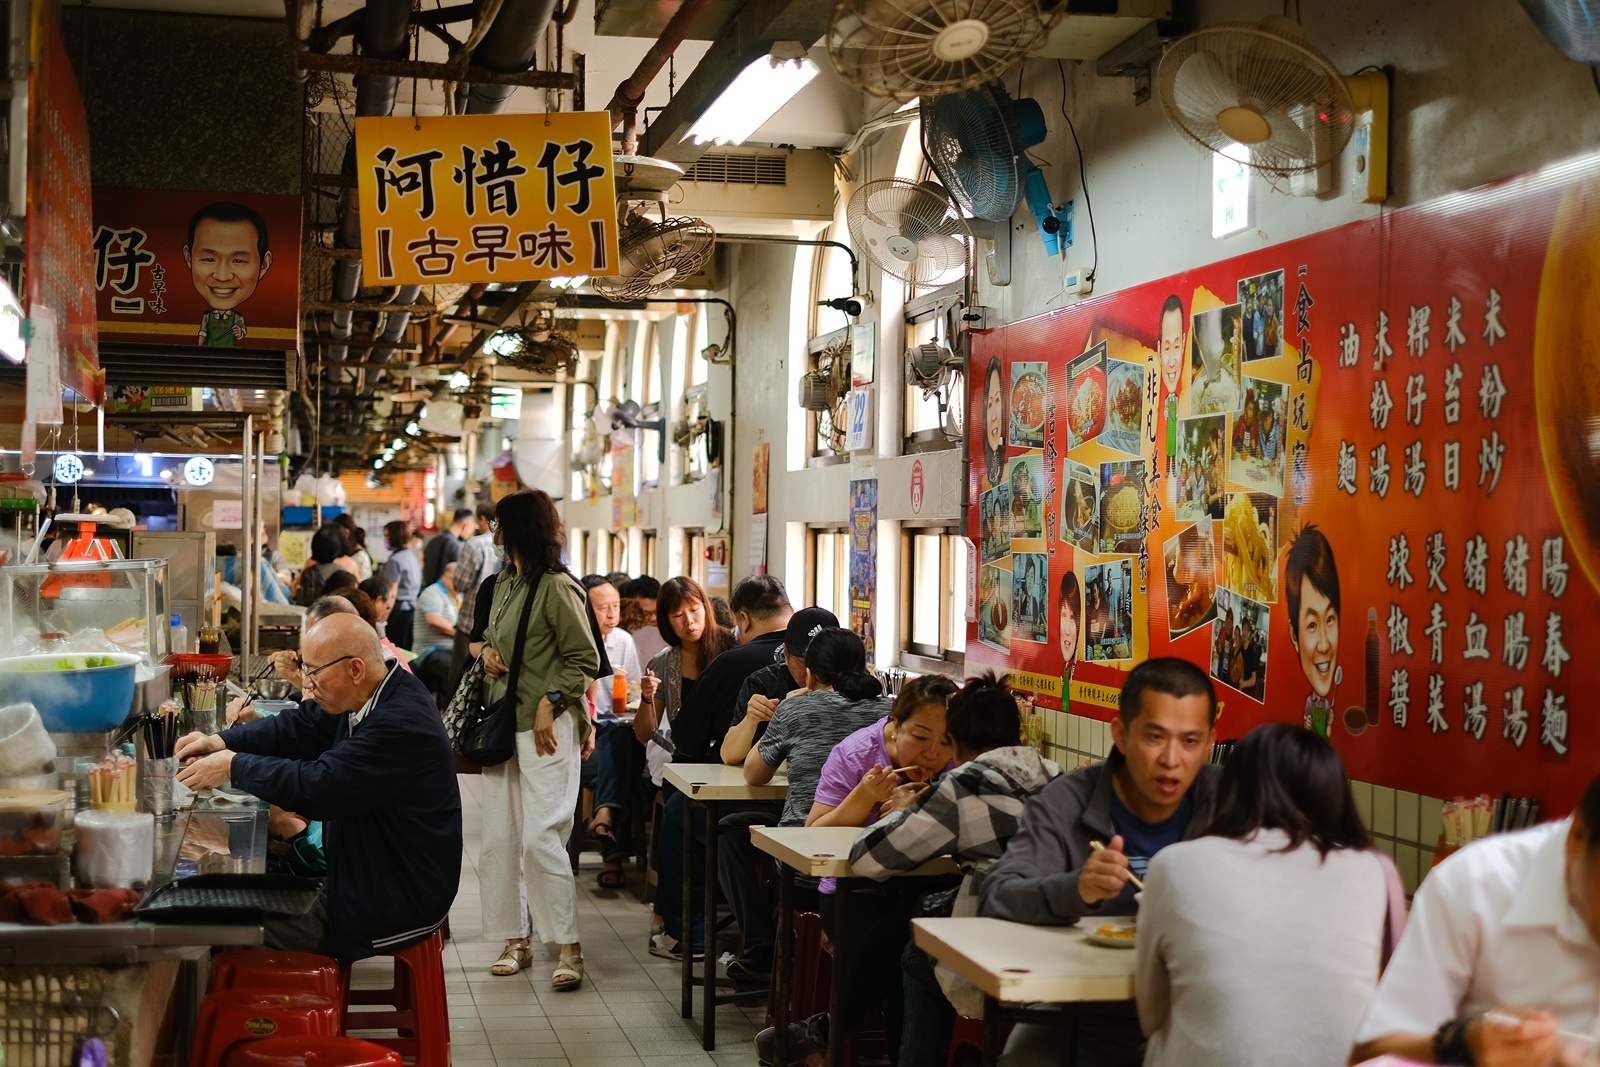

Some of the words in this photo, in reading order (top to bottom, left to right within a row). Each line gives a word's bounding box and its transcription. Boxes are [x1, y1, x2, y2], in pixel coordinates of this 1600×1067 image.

[374, 138, 607, 220] 阿惜仔
[148, 263, 167, 314] 古早味
[853, 392, 866, 433] 22
[1369, 311, 1393, 498] 米粉湯
[1404, 305, 1431, 497] 粿仔湯
[1444, 296, 1467, 491] 米苔目
[1478, 287, 1507, 496] 米粉炒
[1387, 534, 1413, 728] 辣椒醬
[1425, 531, 1448, 734] 燙青菜
[1463, 534, 1490, 740] 豬血湯
[1503, 534, 1530, 747] 豬腸湯
[1541, 536, 1570, 754] 陽春麵
